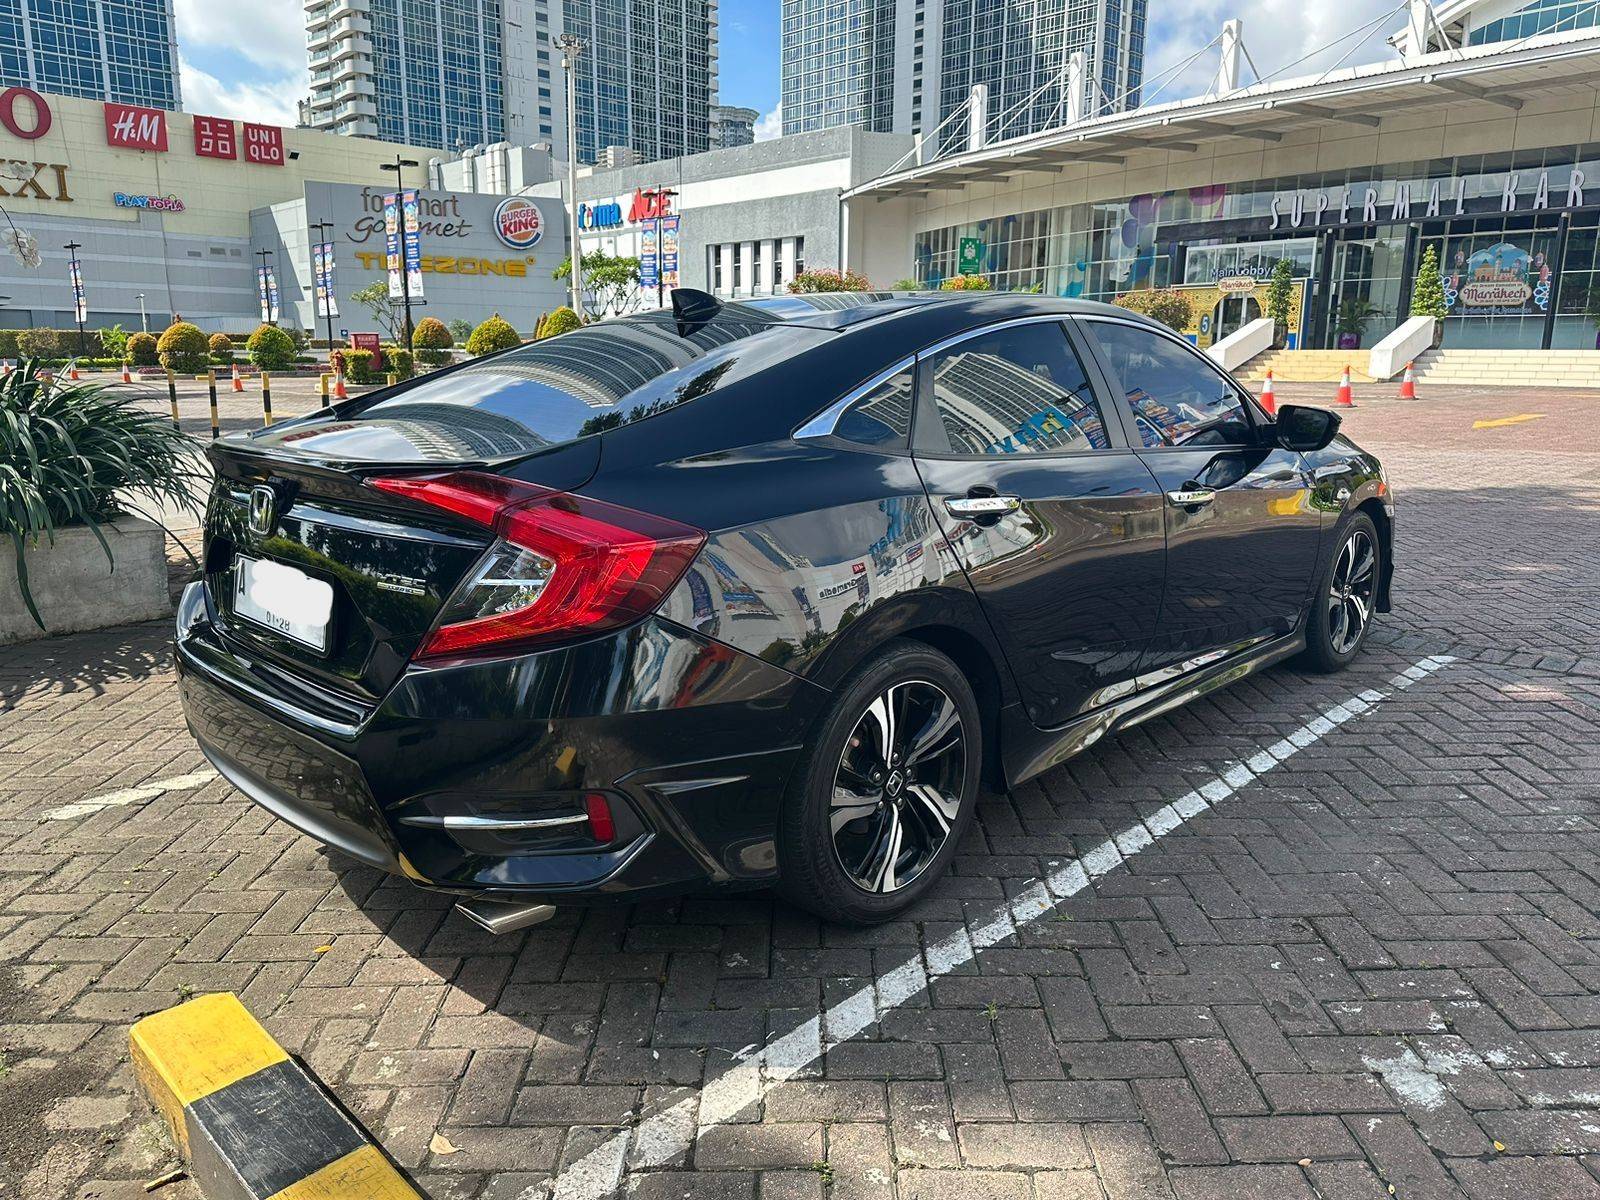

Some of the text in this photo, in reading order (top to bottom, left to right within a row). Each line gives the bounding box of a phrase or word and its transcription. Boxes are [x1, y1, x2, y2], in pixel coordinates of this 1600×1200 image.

[112, 110, 160, 145] H&M
[248, 128, 276, 145] UNI
[249, 144, 280, 161] QLO
[113, 192, 187, 213] PLAYTOPIA
[628, 187, 671, 223] ACE
[1269, 169, 1585, 230] SUPERMAL KAR
[500, 208, 538, 225] BURGER
[502, 216, 539, 236] KING
[355, 252, 528, 277] TIEZONE
[1210, 265, 1271, 279] Main Lobby
[1201, 316, 1209, 333] 5
[238, 560, 246, 595] A
